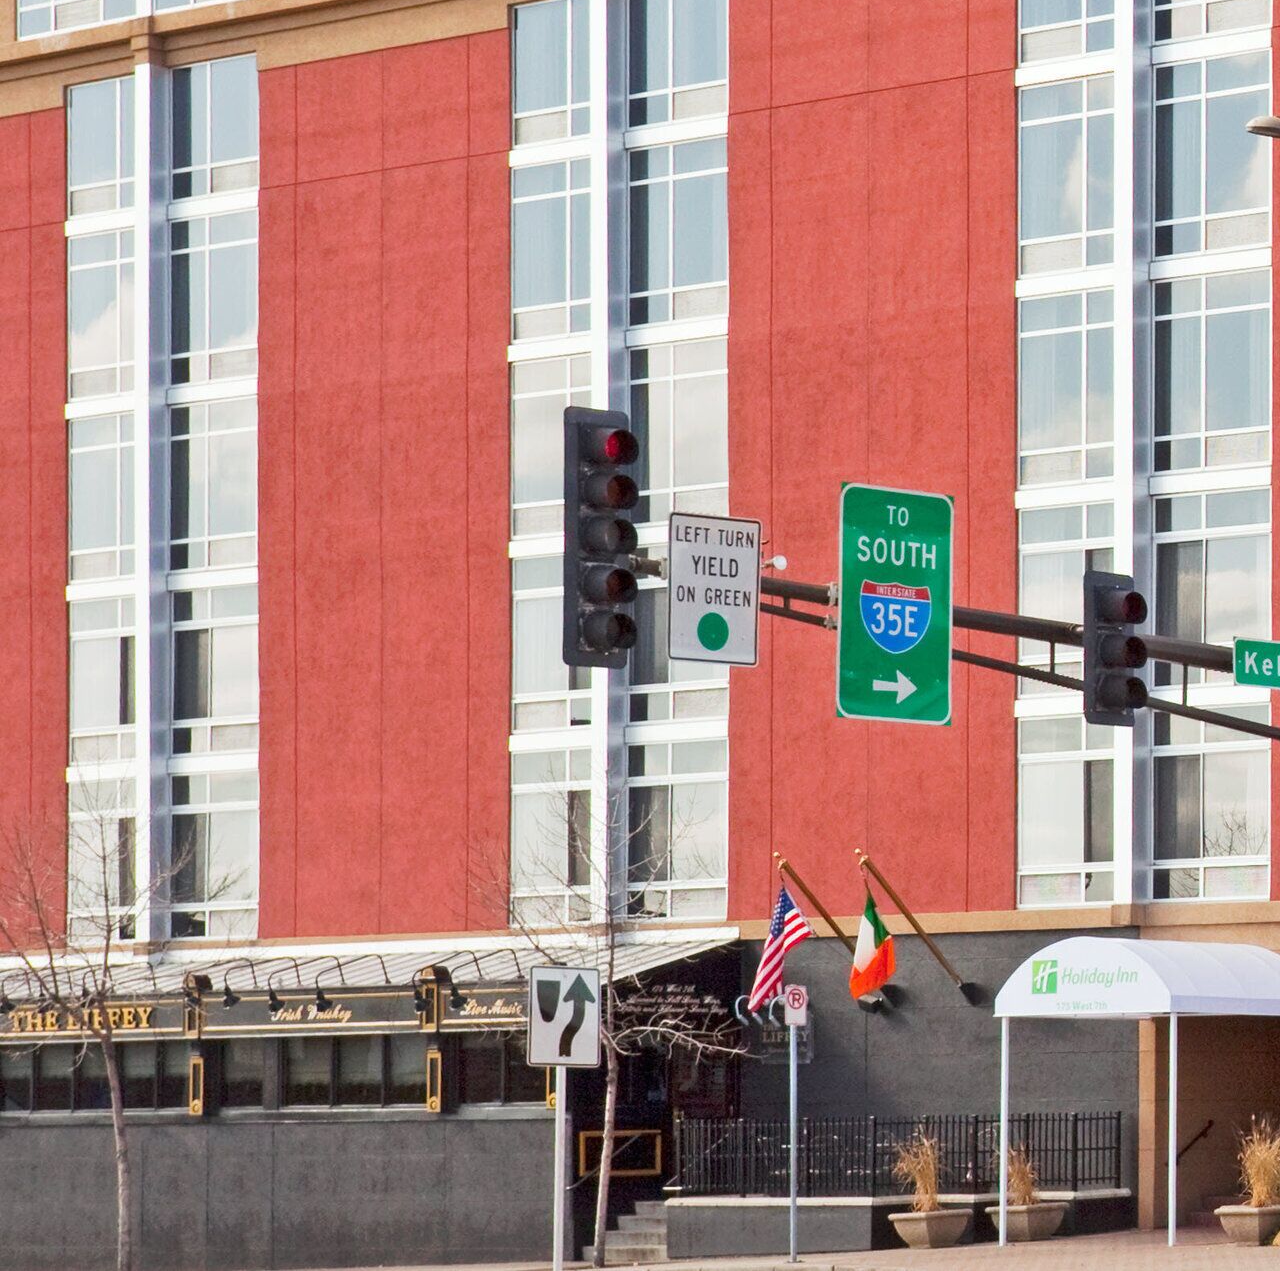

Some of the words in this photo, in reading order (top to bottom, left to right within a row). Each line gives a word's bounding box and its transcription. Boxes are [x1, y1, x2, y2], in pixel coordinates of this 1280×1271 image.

[886, 505, 909, 526] TO
[676, 525, 710, 544] LEFT
[718, 529, 754, 548] TURN
[857, 535, 936, 569] SOUTH
[692, 555, 738, 578] YIELD
[677, 585, 695, 603] ON
[705, 587, 751, 607] GREEN
[876, 585, 916, 599] INTERSTATE
[871, 602, 918, 638] 35E
[1062, 967, 1114, 987] Holiday
[1116, 966, 1139, 983] Inn
[8, 1009, 59, 1032] THE
